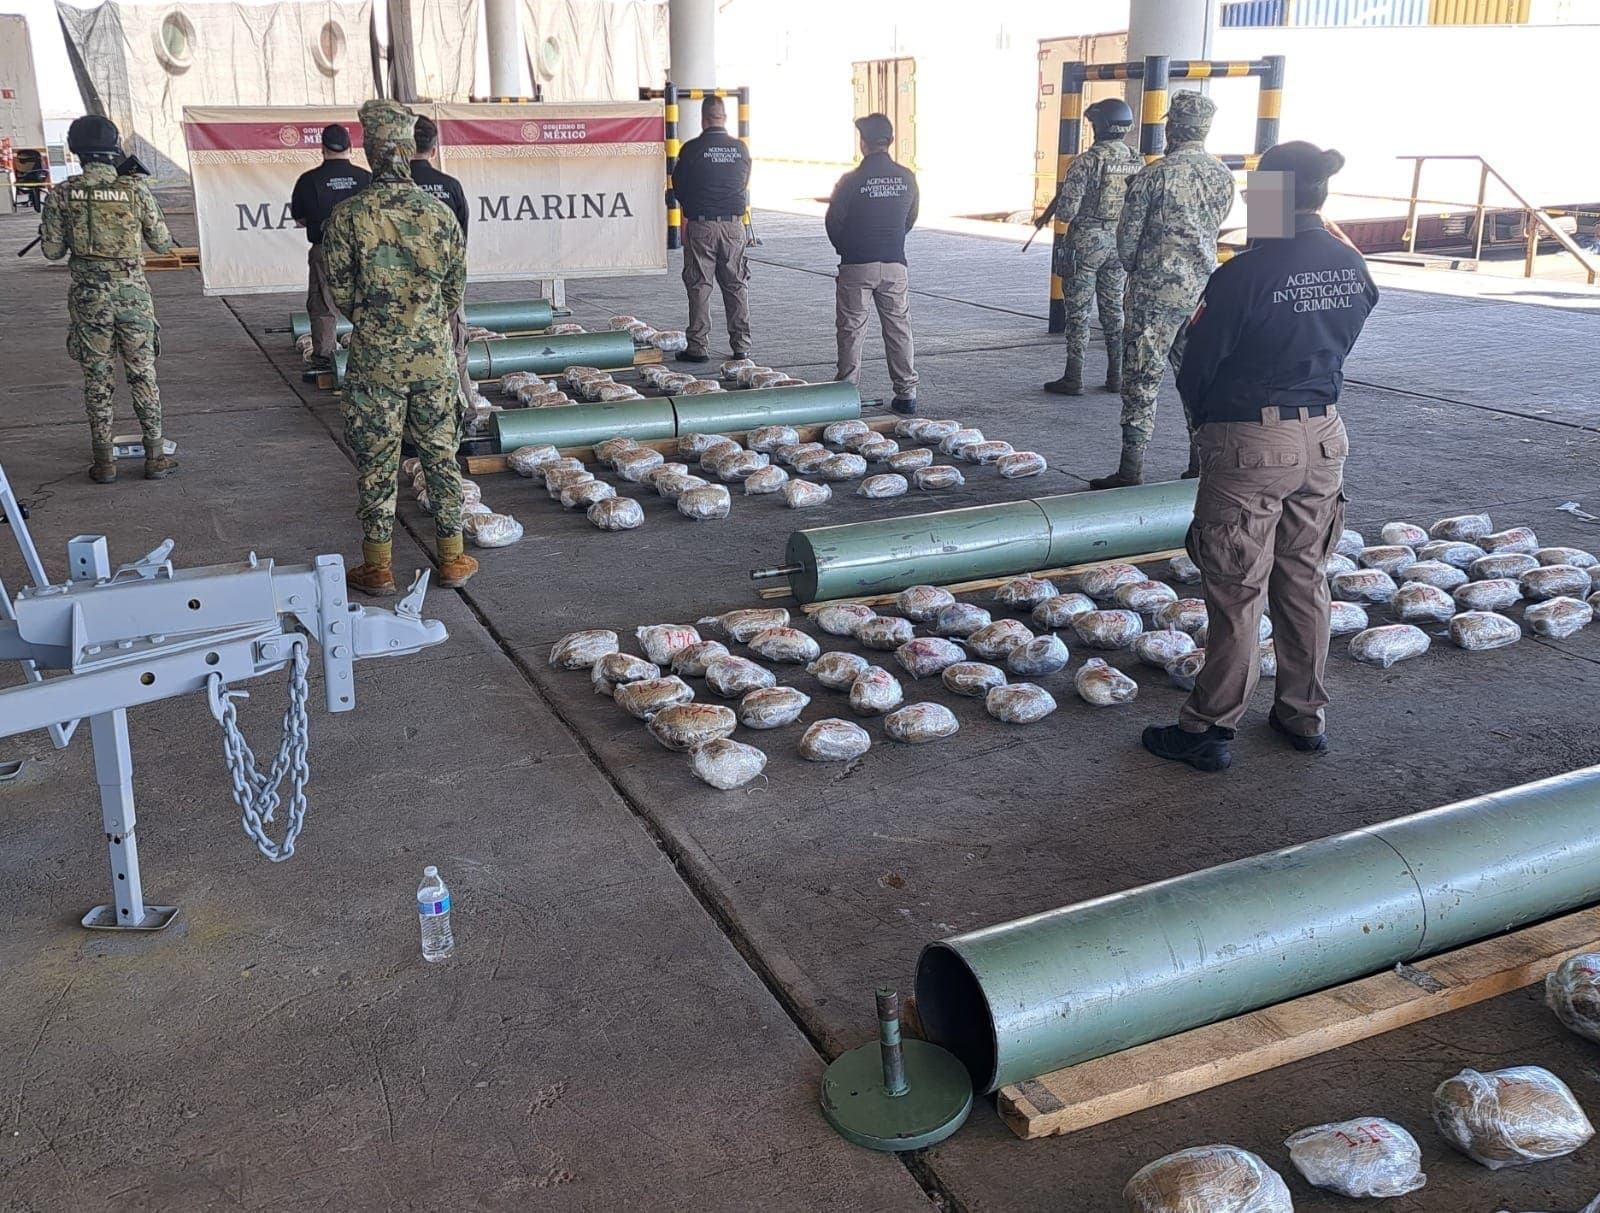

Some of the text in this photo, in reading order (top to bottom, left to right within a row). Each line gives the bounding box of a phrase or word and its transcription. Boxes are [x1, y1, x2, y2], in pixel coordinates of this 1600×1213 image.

[543, 130, 586, 140] MÉXICO
[477, 191, 634, 222] MARINA
[1286, 268, 1357, 287] AGENCIA DE
[1273, 281, 1366, 304] INVESTIGACIÓN
[1293, 296, 1353, 313] CRIMINAL
